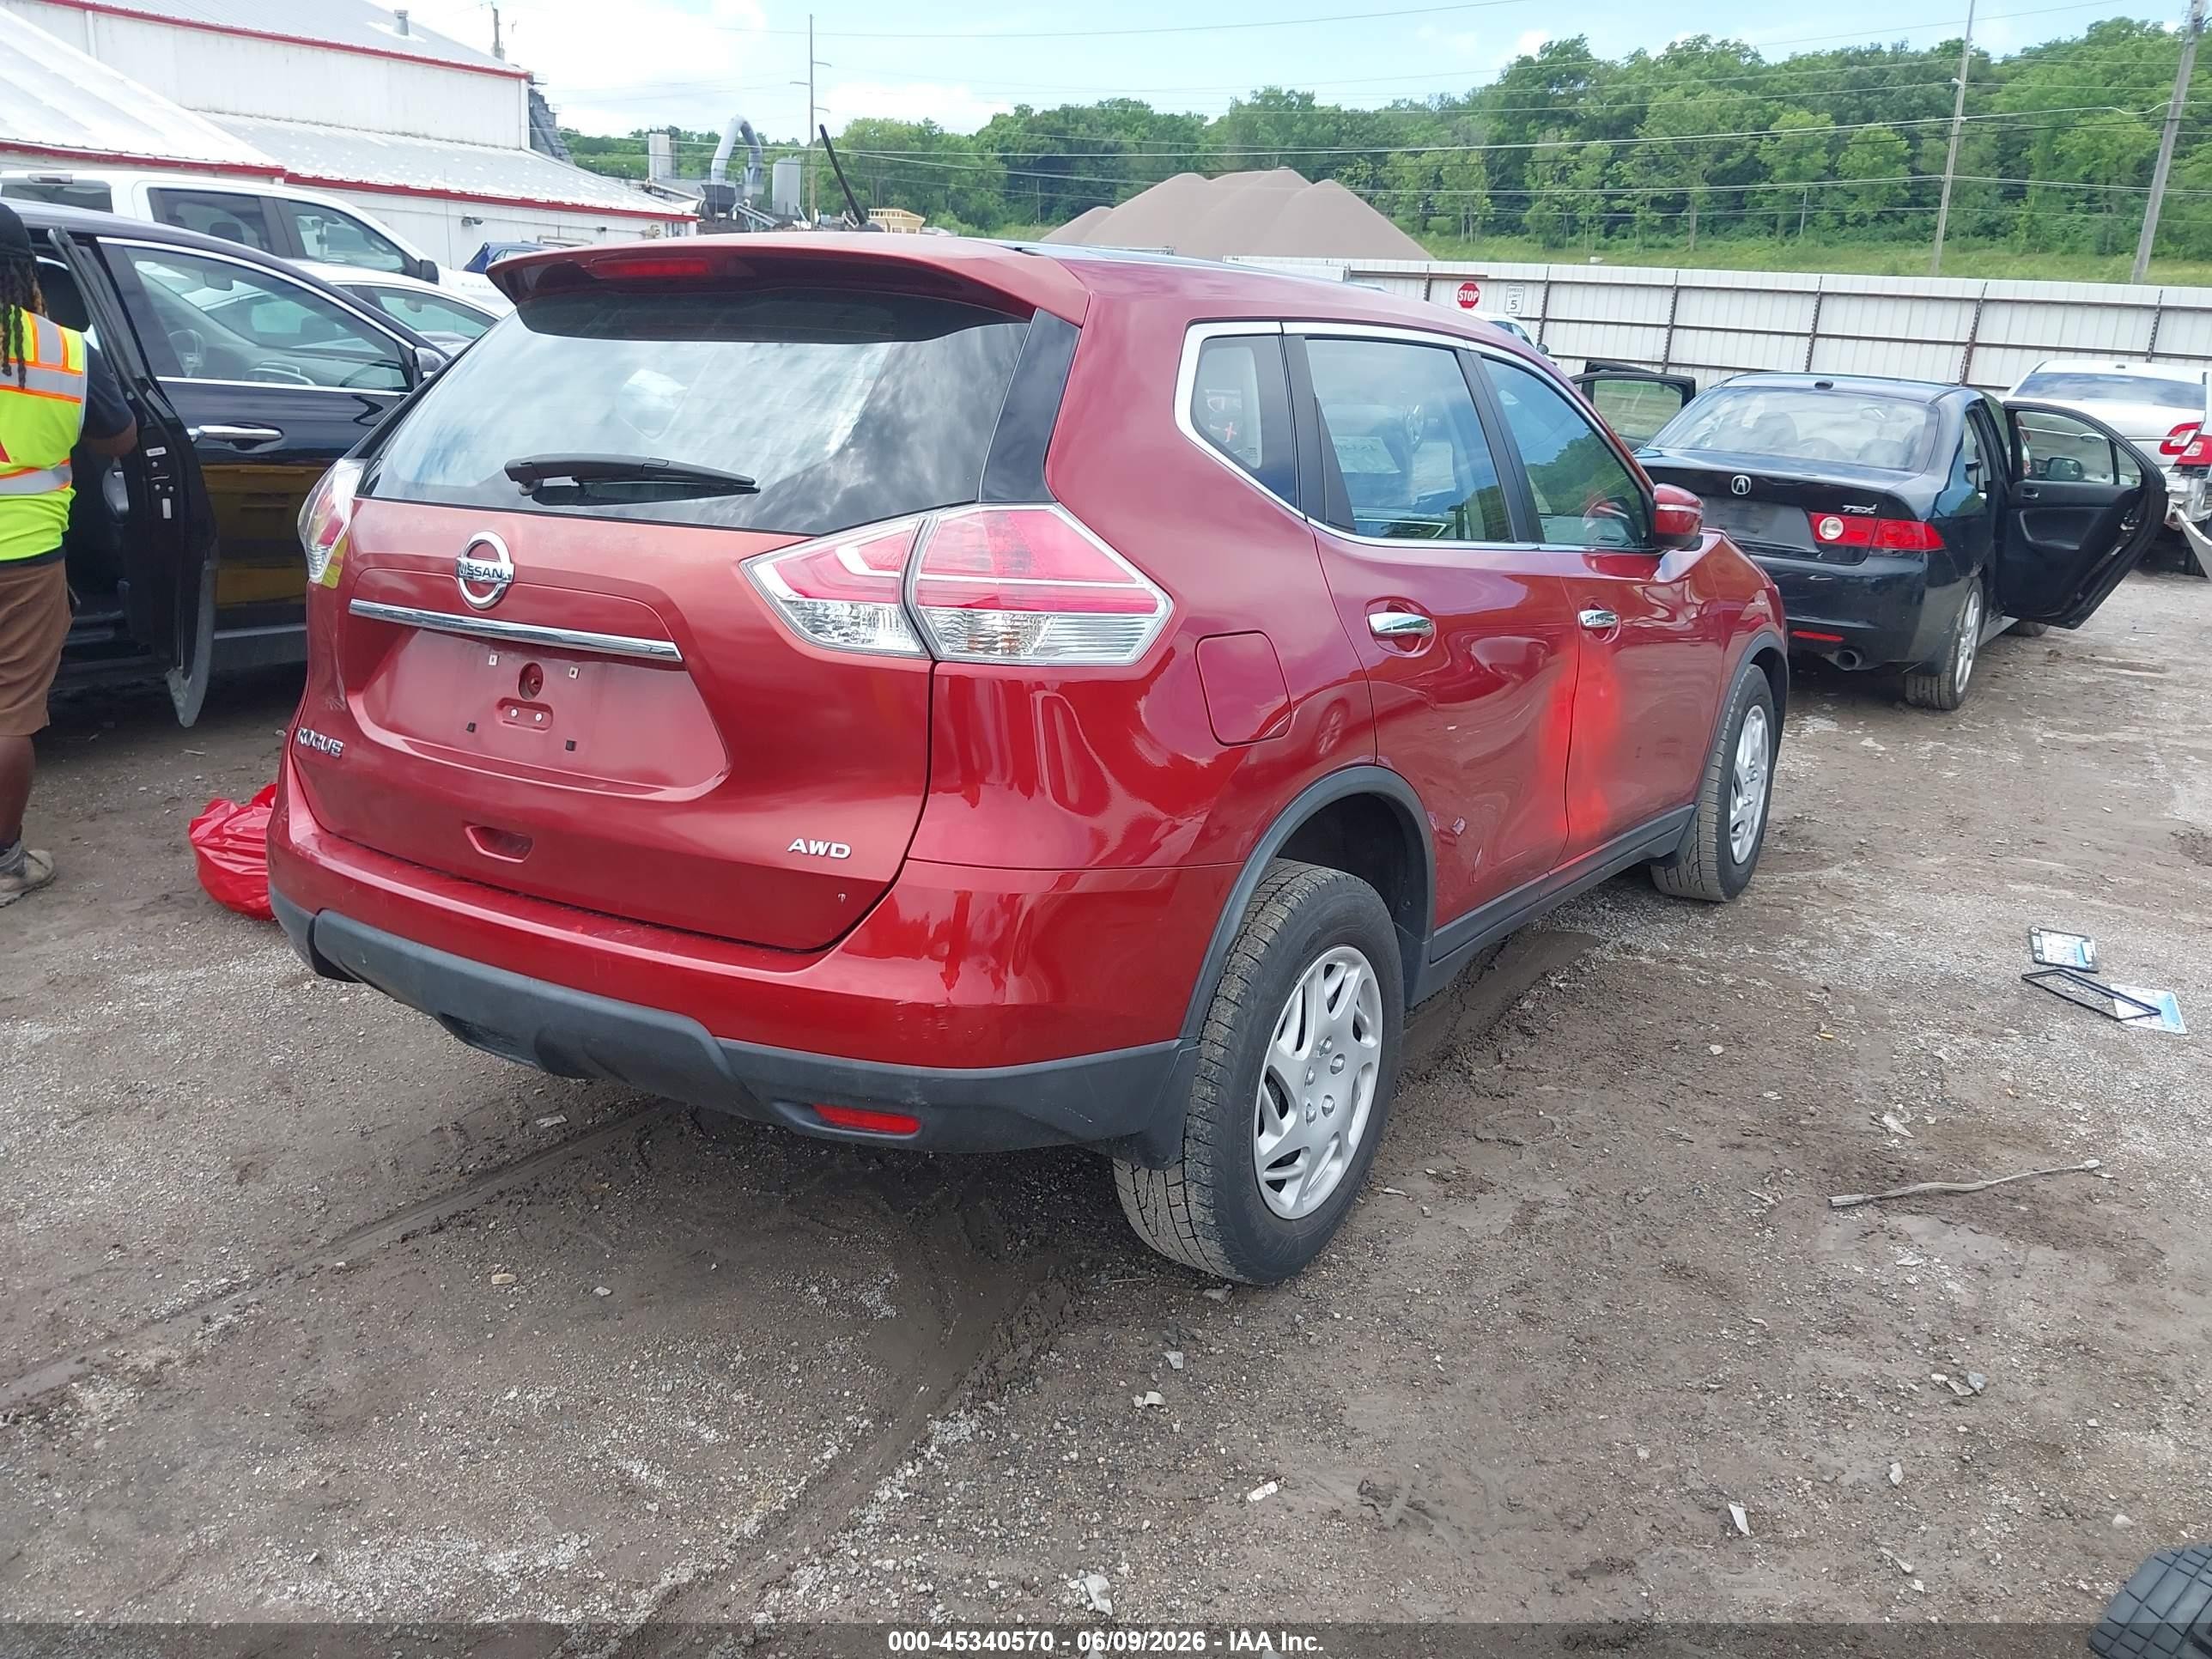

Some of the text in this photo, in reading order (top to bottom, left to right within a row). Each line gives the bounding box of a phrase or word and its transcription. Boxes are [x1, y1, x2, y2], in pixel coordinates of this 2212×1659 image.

[1458, 289, 1479, 302] STOP
[1510, 300, 1517, 310] 5
[458, 561, 504, 580] NISSAN
[787, 838, 852, 860] AWD
